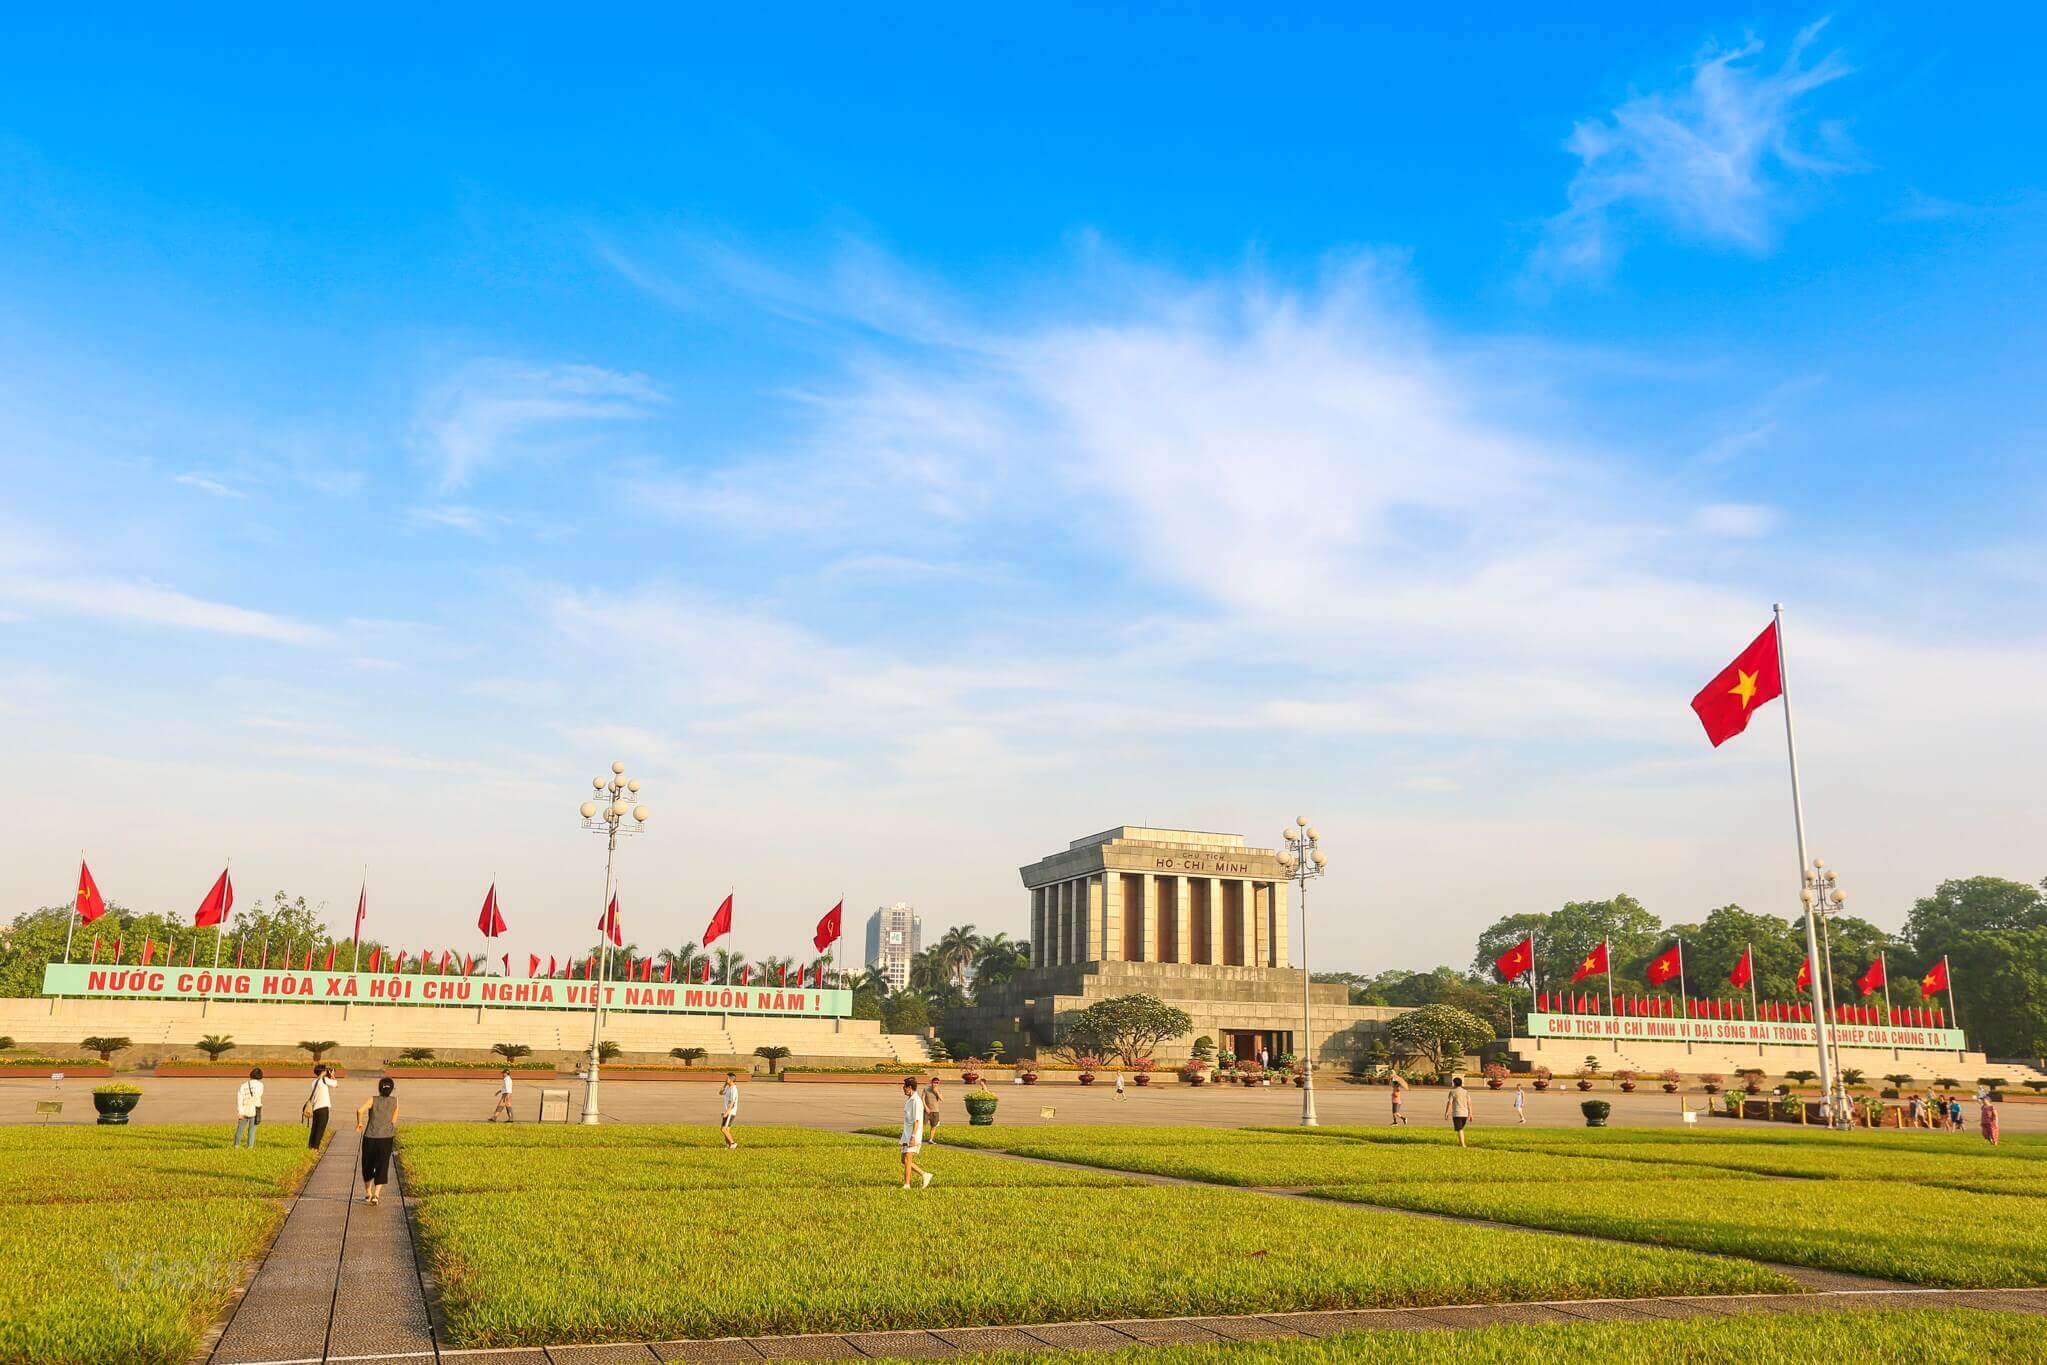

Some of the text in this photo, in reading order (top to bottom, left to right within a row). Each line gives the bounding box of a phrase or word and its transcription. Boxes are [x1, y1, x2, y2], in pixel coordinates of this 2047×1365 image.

[1215, 862, 1248, 873] MINH
[88, 968, 165, 992] NƯỚC
[177, 970, 251, 996] CỘNG
[262, 972, 314, 996] HÒA
[325, 975, 358, 997] XÃ
[370, 976, 413, 1001] HỘI
[422, 976, 472, 1000] CHỦ
[481, 981, 554, 1003] NGHĨA
[625, 987, 676, 1007] NAM
[684, 988, 749, 1009] MUÔN
[757, 990, 805, 1010] NĂM
[1647, 1022, 1676, 1037] MINH
[1773, 1026, 1808, 1041] TRONG
[1927, 1033, 1941, 1046] TA
